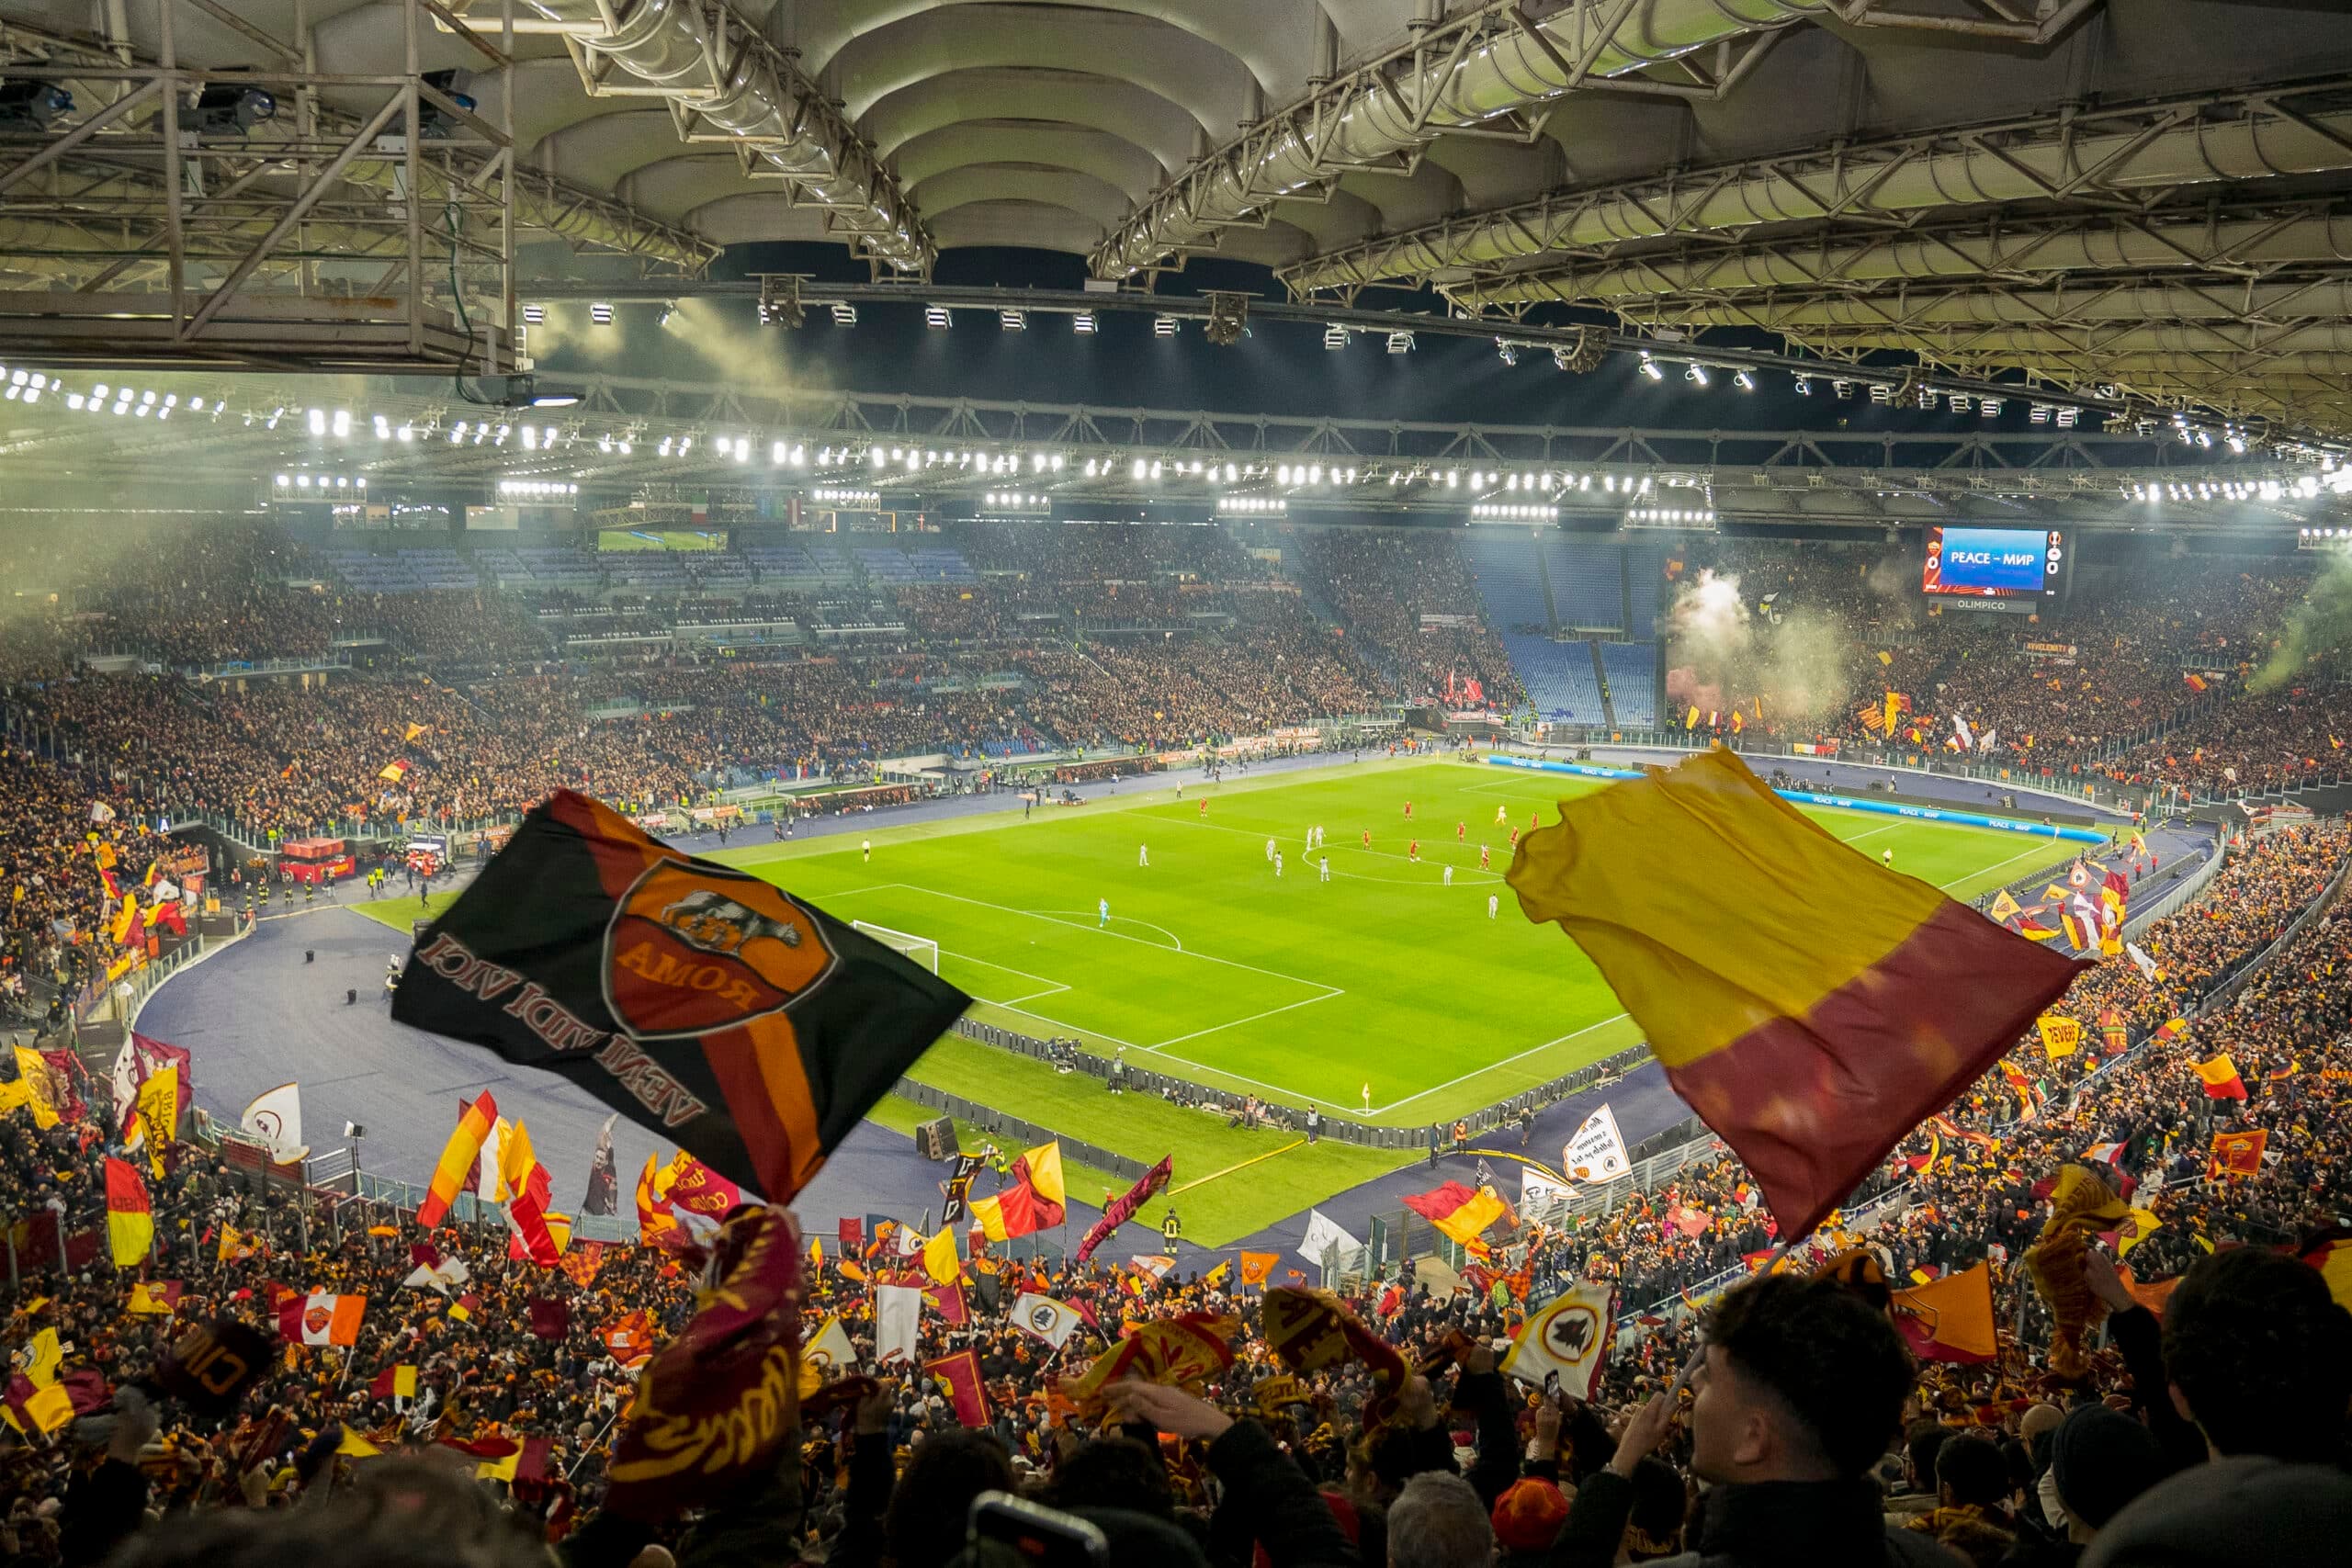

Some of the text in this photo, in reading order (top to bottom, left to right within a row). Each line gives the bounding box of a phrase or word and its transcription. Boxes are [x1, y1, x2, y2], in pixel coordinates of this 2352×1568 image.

[1928, 557, 1939, 570] 0
[1951, 552, 1990, 565] PEACE
[2003, 554, 2034, 566] МИР
[2046, 561, 2058, 574] 0
[1958, 600, 2006, 610] OLIMPICO
[160, 818, 169, 832] A
